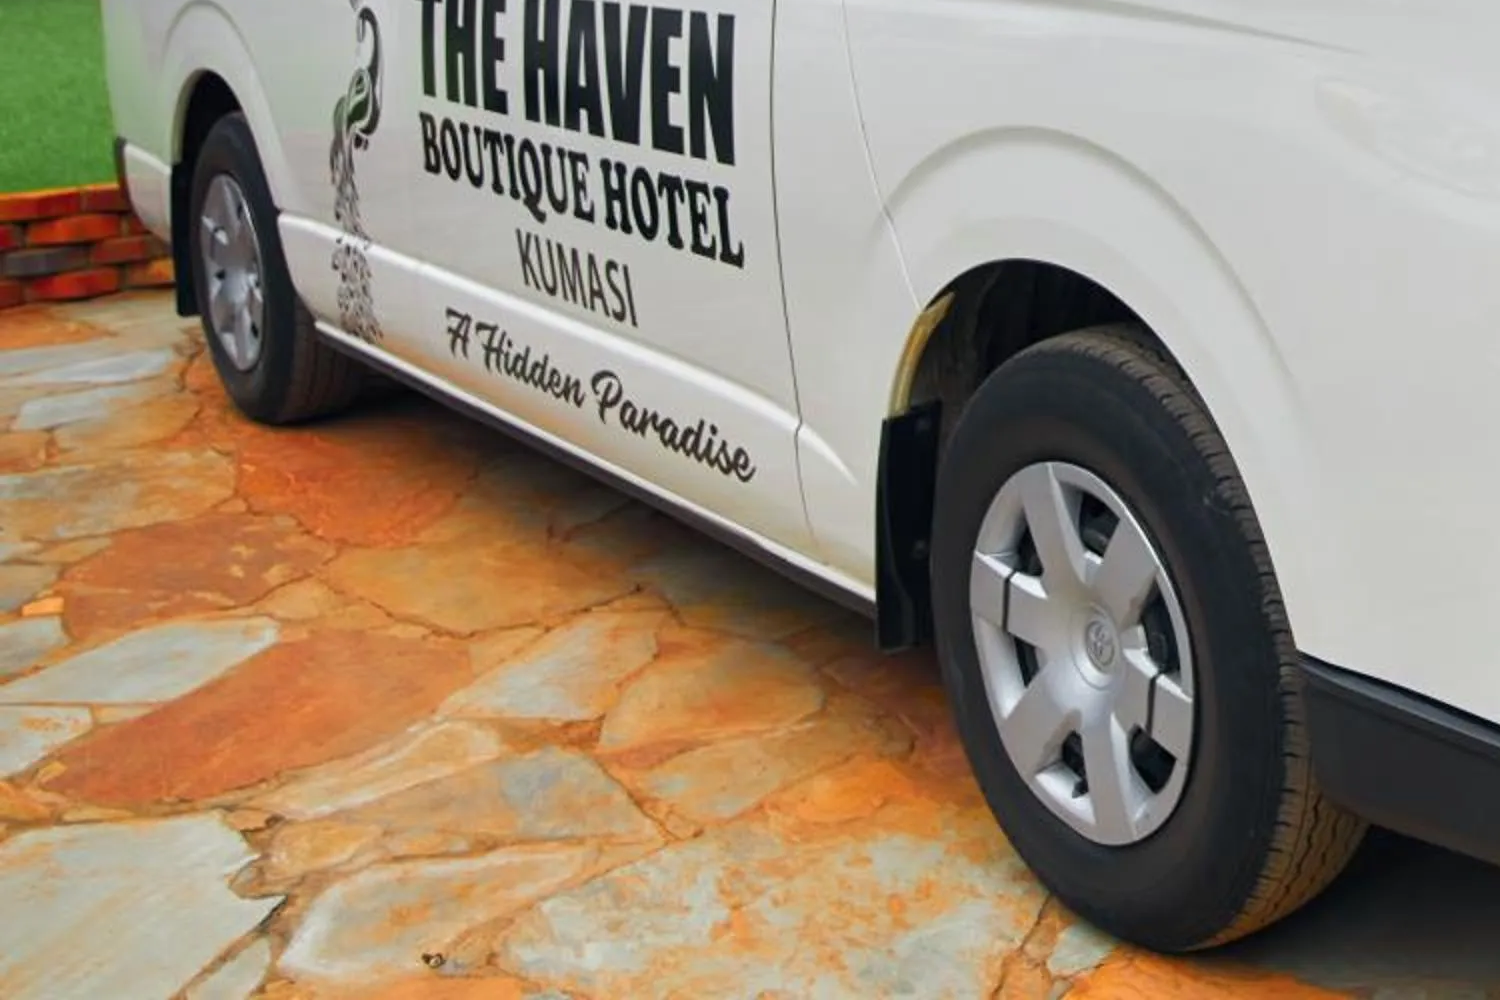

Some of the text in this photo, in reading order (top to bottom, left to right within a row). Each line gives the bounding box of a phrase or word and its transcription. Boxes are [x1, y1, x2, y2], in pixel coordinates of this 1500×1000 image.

[419, 111, 744, 269] BOUTIQUE HOTEL
[515, 228, 638, 328] KUMASI
[444, 307, 756, 482] A Hidden Paradise
